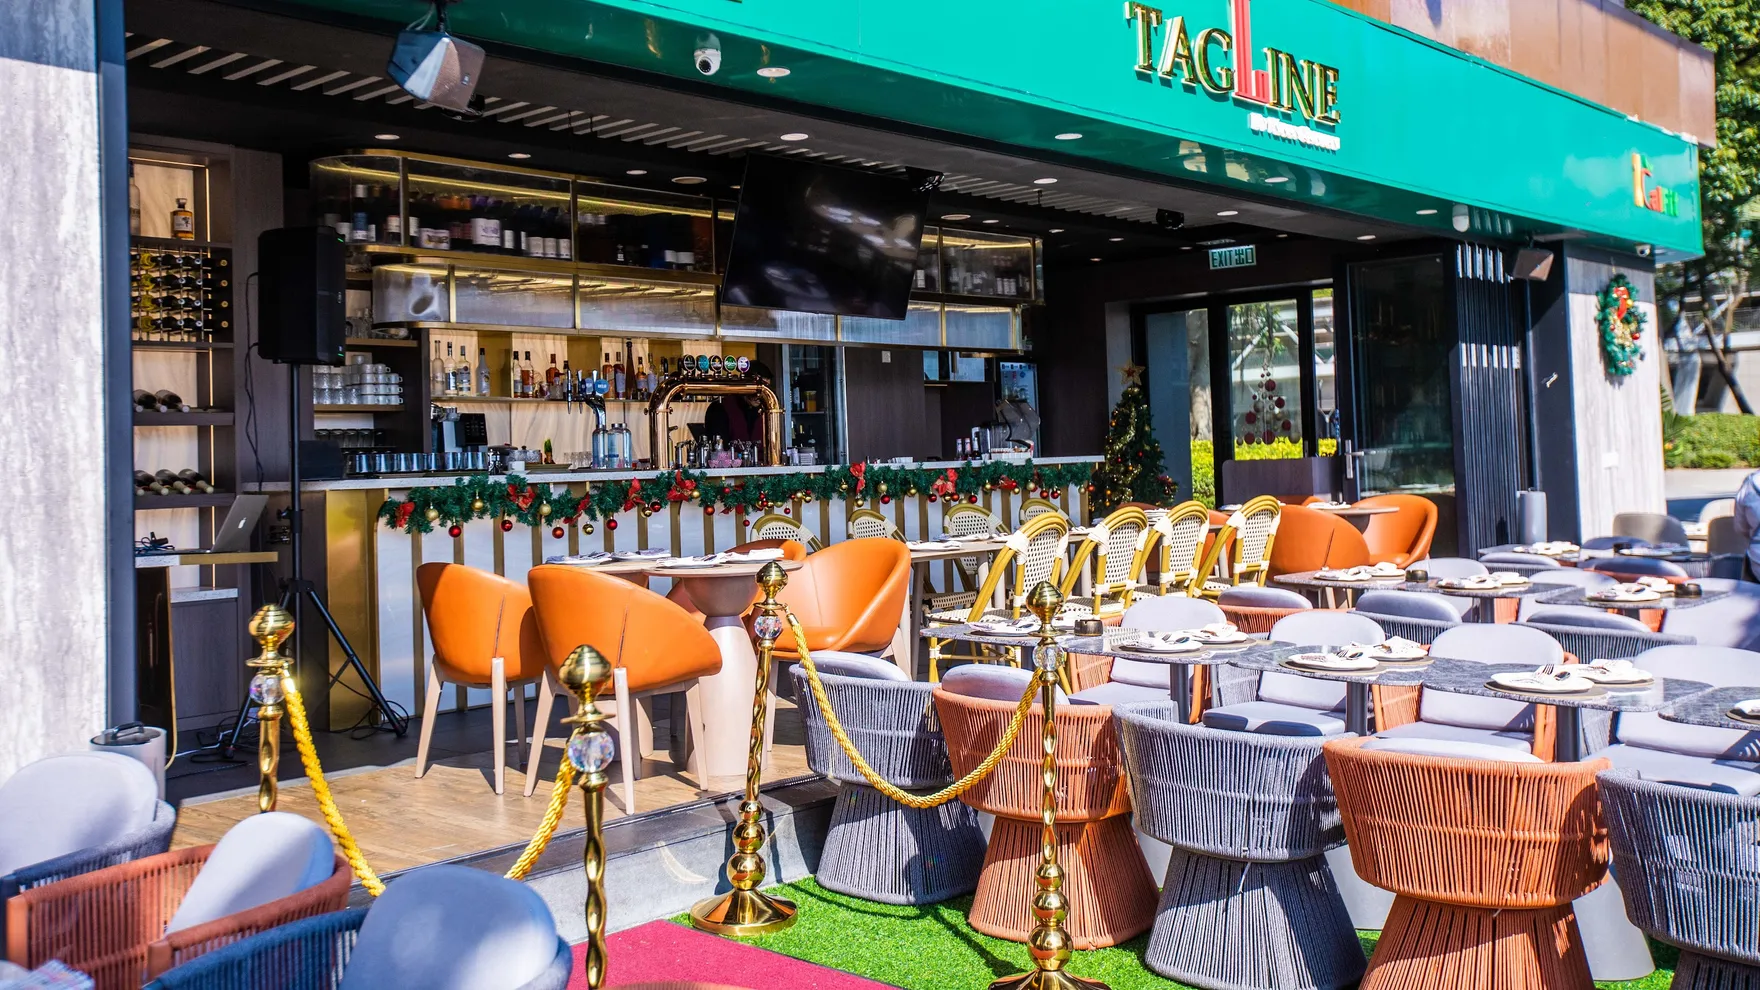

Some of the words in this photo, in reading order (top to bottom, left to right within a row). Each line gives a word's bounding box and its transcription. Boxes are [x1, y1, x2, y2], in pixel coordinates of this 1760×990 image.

[1124, 0, 1341, 126] TAGLINE
[1211, 250, 1233, 267] EXIT
[1235, 248, 1254, 265] 出口
